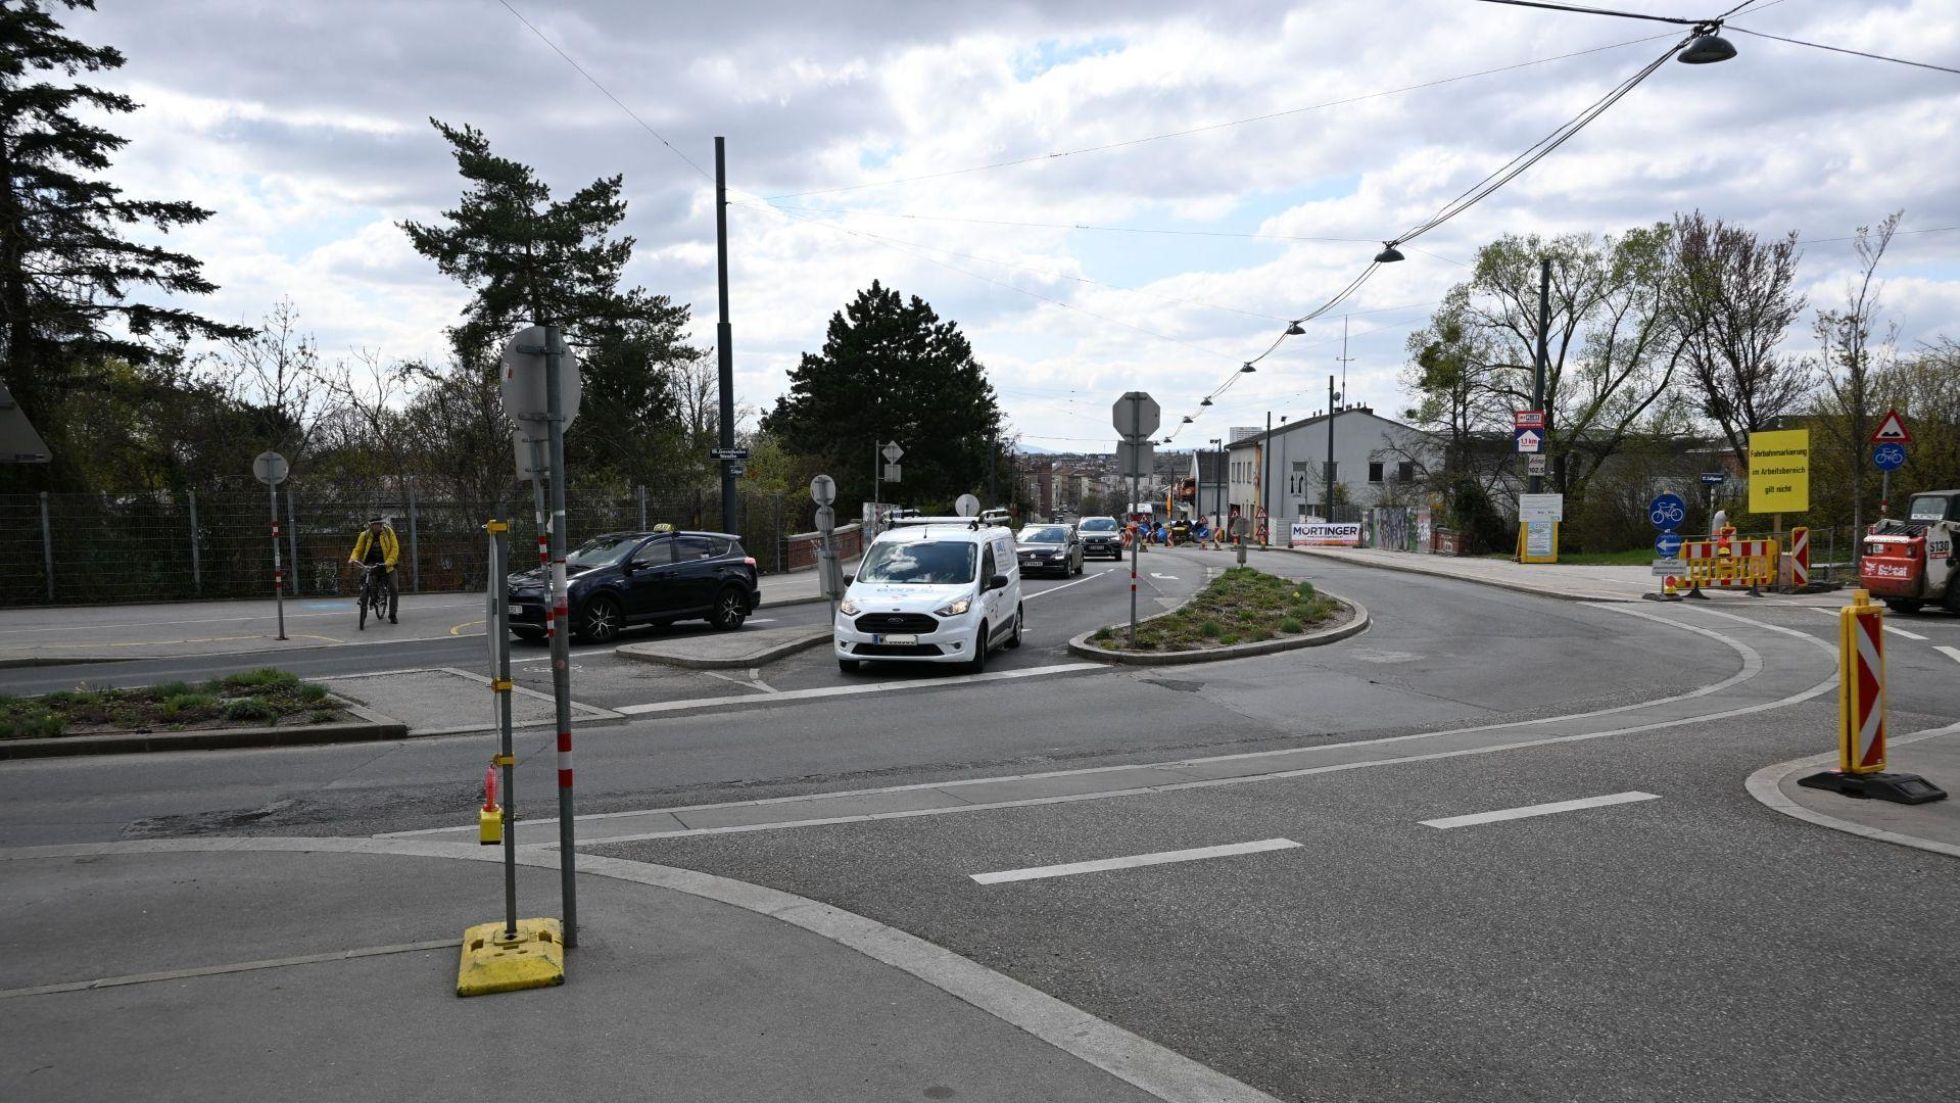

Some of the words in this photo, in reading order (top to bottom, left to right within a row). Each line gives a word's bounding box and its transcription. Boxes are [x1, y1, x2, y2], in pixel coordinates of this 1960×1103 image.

[1750, 449, 1808, 457] Fahrbahnmarkierung
[1761, 466, 1805, 475] Arbeitsbereich
[1765, 486, 1774, 495] gilt
[1776, 485, 1792, 493] nicht
